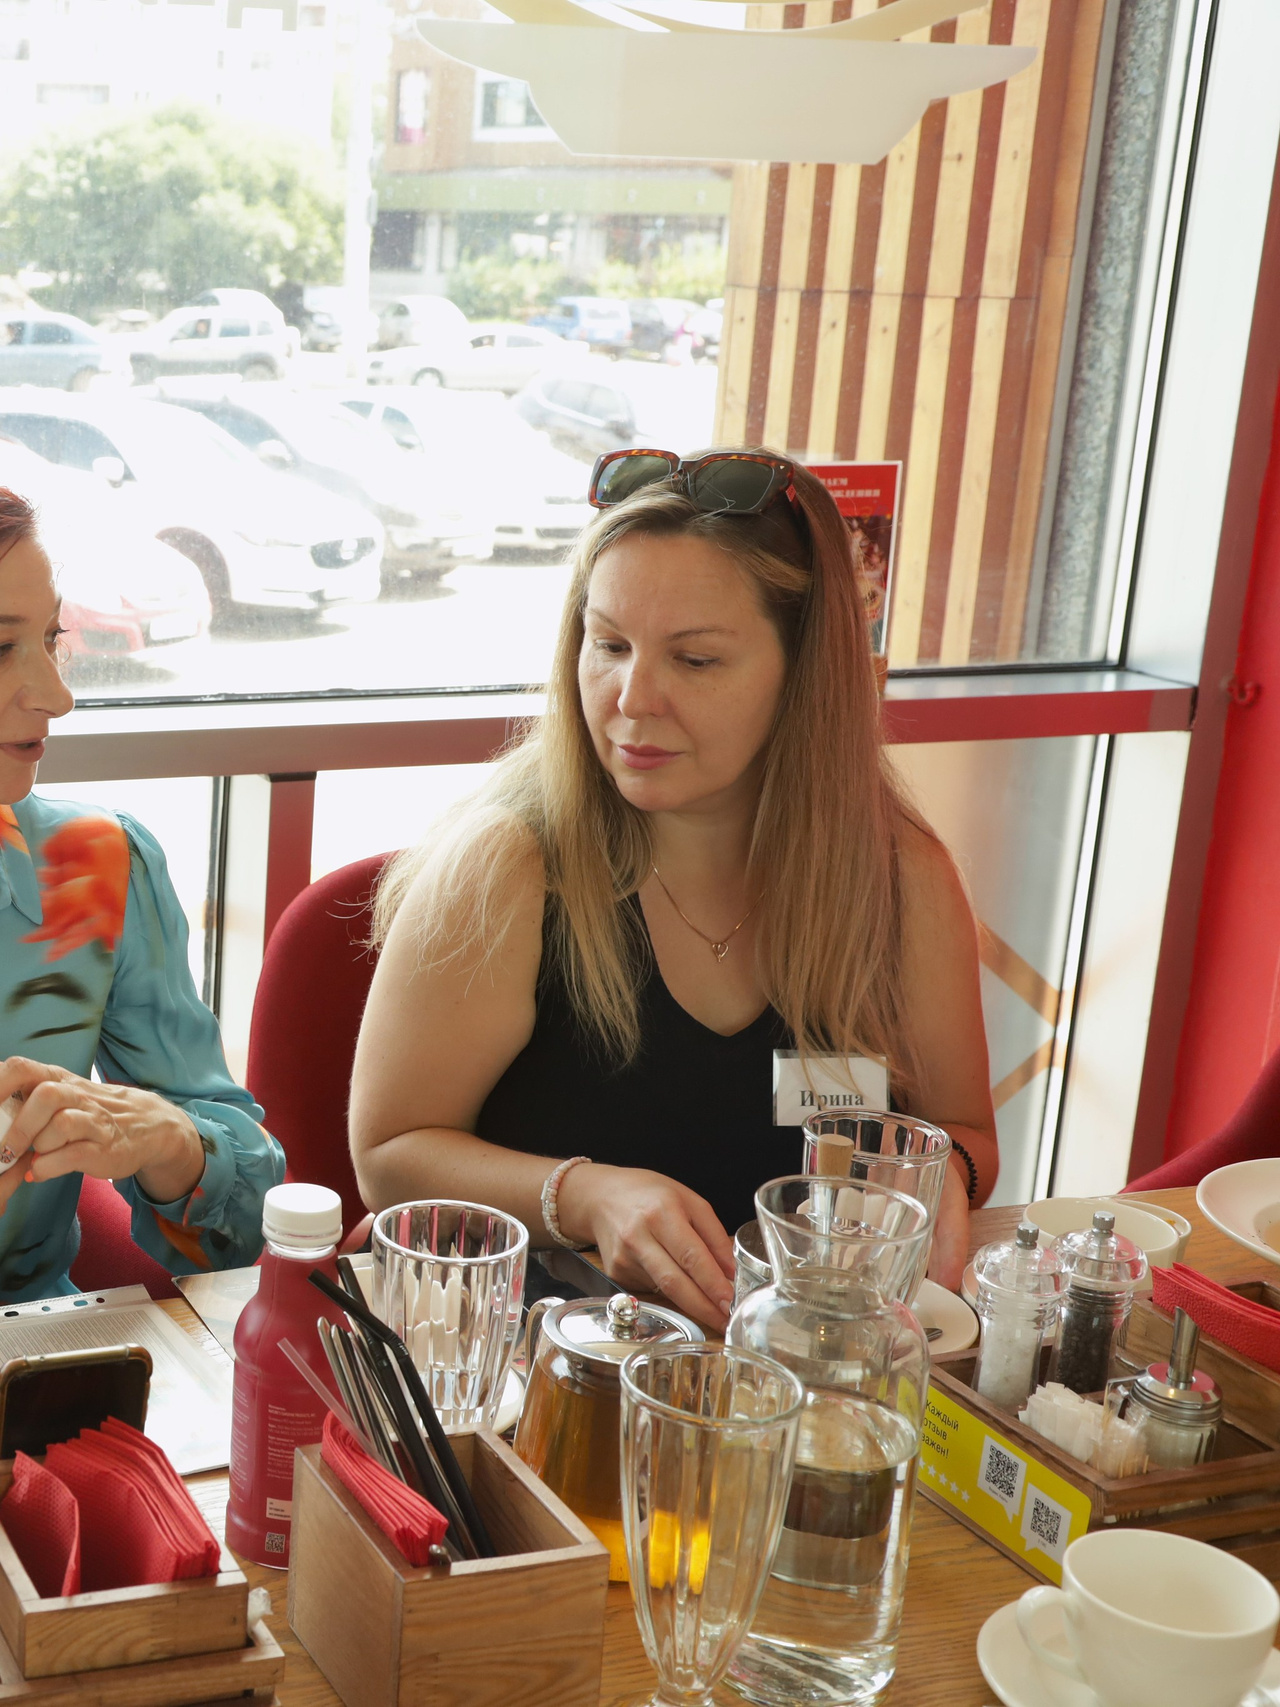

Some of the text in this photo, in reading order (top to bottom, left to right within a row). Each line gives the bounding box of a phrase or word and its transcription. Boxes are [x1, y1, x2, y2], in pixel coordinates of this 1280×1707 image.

[800, 1090, 865, 1111] Ирина
[925, 1399, 960, 1432] Каждый
[923, 1417, 948, 1441] отзыв
